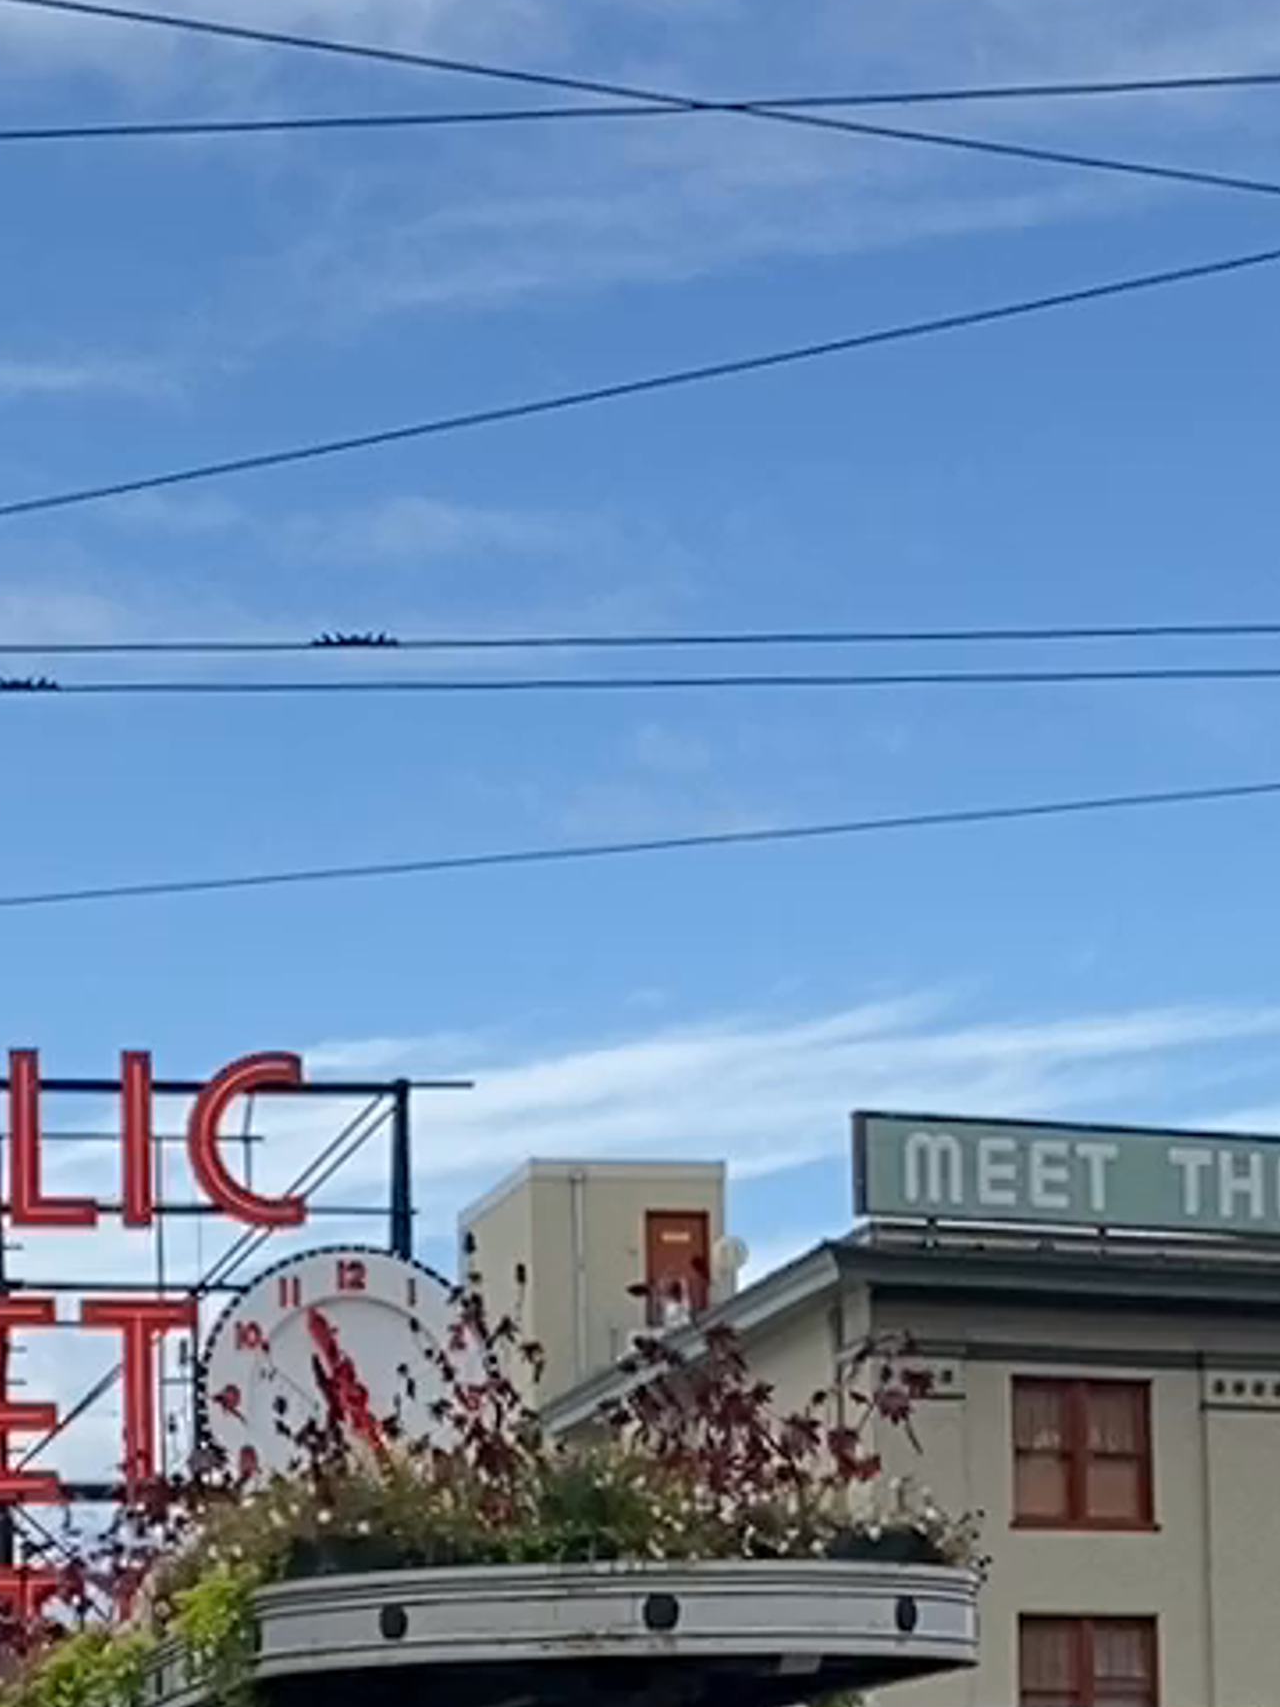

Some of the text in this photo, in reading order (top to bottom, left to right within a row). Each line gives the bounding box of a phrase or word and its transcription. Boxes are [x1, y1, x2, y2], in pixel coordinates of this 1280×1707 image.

[903, 1131, 1119, 1212] MEET
[336, 1260, 366, 1290] 12
[280, 1277, 301, 1308] 11
